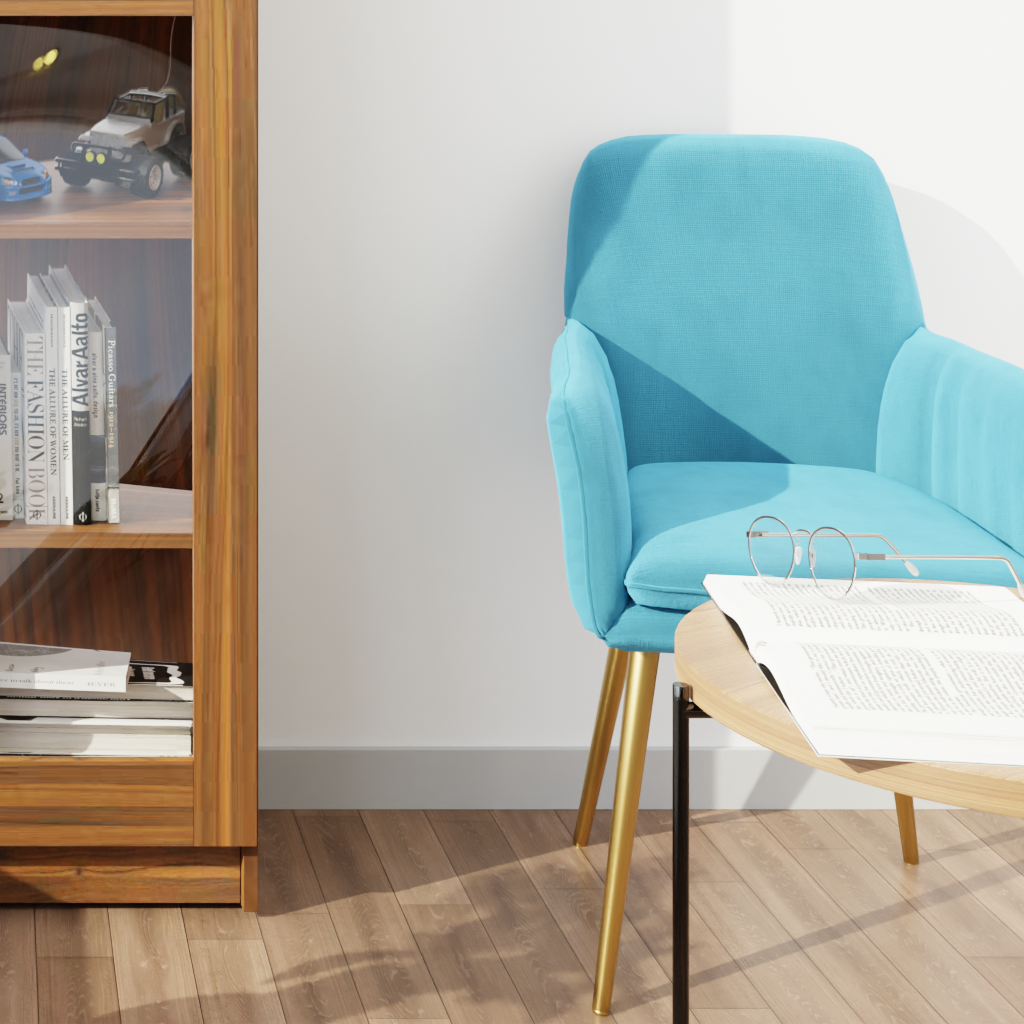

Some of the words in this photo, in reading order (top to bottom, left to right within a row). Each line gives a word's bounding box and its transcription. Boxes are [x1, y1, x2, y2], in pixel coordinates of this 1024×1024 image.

[71, 313, 88, 360] Aalto
[27, 336, 44, 375] THE
[107, 339, 116, 372] Picasso
[48, 368, 56, 387] THE
[71, 361, 88, 406] Alvar
[107, 373, 116, 408] Guitars
[27, 381, 45, 463] FASHION
[61, 389, 69, 425] ALLURE
[91, 401, 99, 418] design
[49, 426, 57, 439] OF
[62, 426, 69, 439] OF
[62, 440, 70, 461] MEN
[28, 468, 46, 521] BOOK
